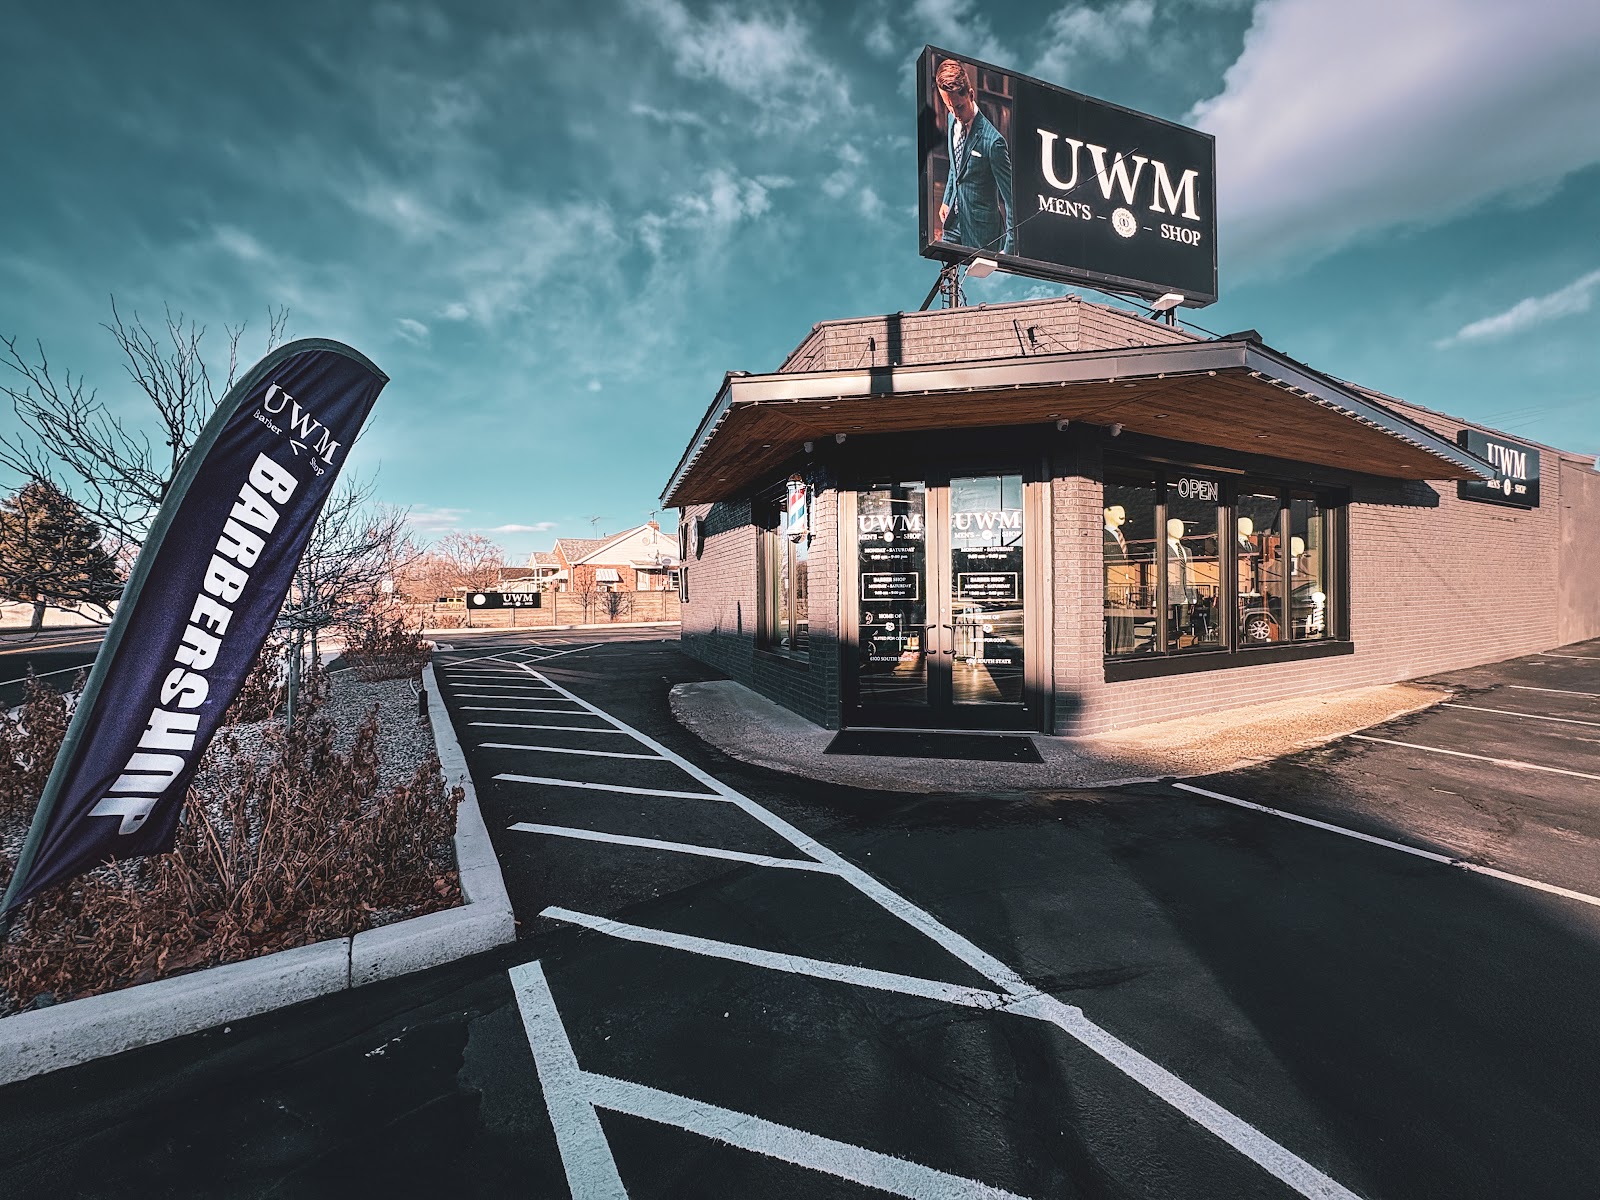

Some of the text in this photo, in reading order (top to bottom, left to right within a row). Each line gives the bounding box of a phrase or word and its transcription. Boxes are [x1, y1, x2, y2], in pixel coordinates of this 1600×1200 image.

[1037, 128, 1200, 221] UWM
[1038, 194, 1201, 246] MEN'S SHOP
[253, 409, 325, 476] Barber Shop
[264, 381, 341, 465] UWM
[1486, 443, 1526, 480] UWM
[1178, 478, 1218, 501] OPEN
[858, 514, 921, 531] UWM
[954, 511, 1021, 530] UWM
[503, 593, 533, 602] UWM
[87, 452, 299, 836] BARBERSHOP
